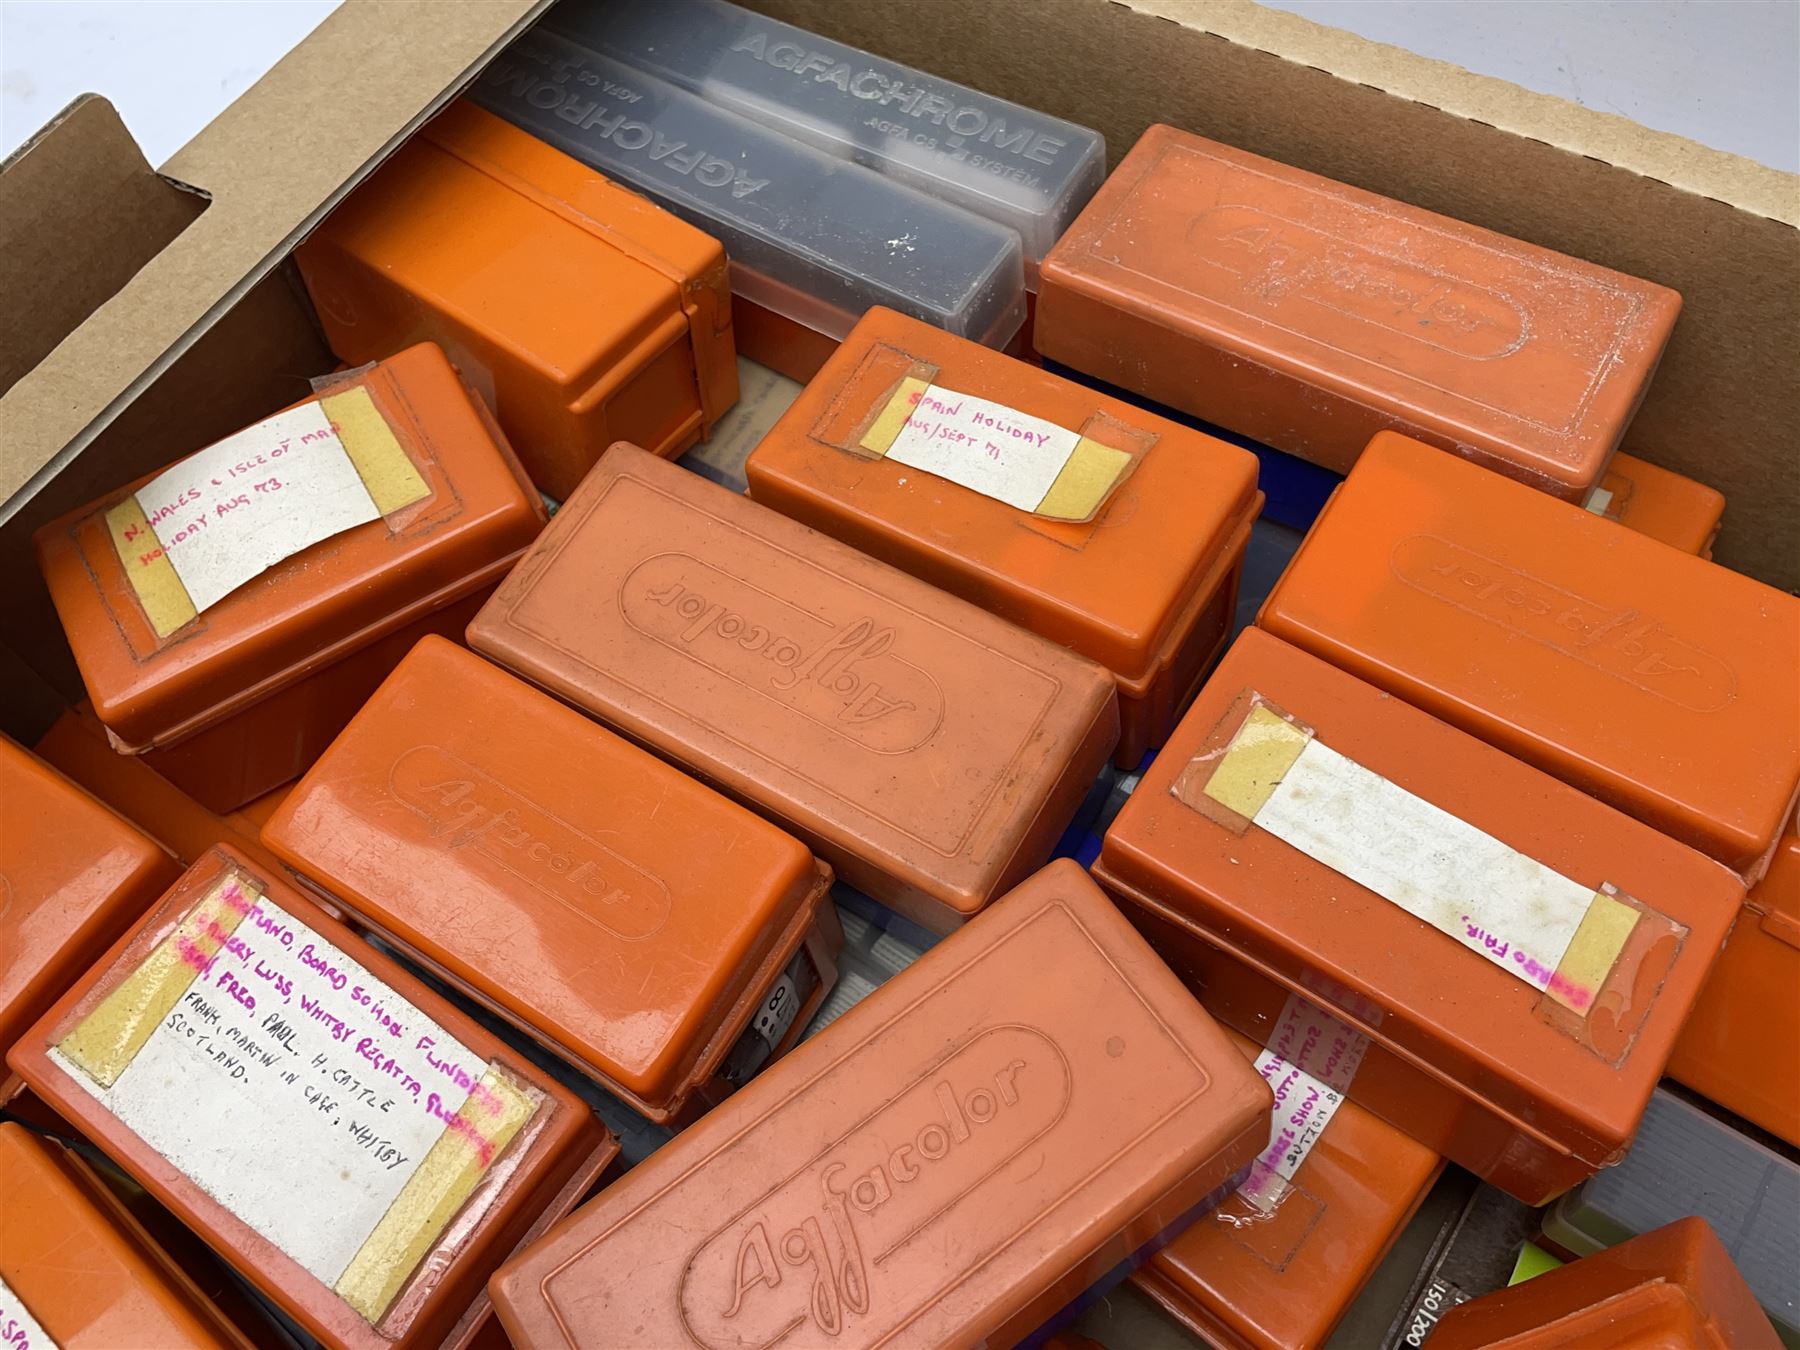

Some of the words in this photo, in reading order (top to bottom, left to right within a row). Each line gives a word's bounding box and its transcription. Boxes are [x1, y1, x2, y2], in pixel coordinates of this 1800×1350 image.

[486, 62, 772, 199] AGFACHROM
[603, 81, 645, 104] AGFA
[730, 32, 1067, 165] AGFACHROME
[863, 117, 910, 140] AGFA
[913, 133, 940, 150] CS
[970, 153, 1041, 188] SYSTEM
[908, 391, 964, 416] SPAIN
[971, 411, 1051, 448] HOLIDAY
[145, 487, 202, 528] WALES
[227, 455, 268, 478] ISLE
[270, 437, 292, 458] OF
[138, 513, 208, 568] HOLIDAY
[214, 494, 252, 518] AUG
[645, 582, 917, 724] Agfacolor
[1430, 562, 1700, 676] Agfacolor
[416, 779, 632, 905] Agfacolor
[297, 943, 348, 991] BOARD
[299, 993, 357, 1043] WHITBY
[225, 1026, 283, 1068] MARTIN
[279, 1070, 301, 1086] IN
[348, 1120, 409, 1171] WHITBY
[332, 1068, 396, 1114] CATTLE
[721, 1059, 1026, 1336] Agfacolor
